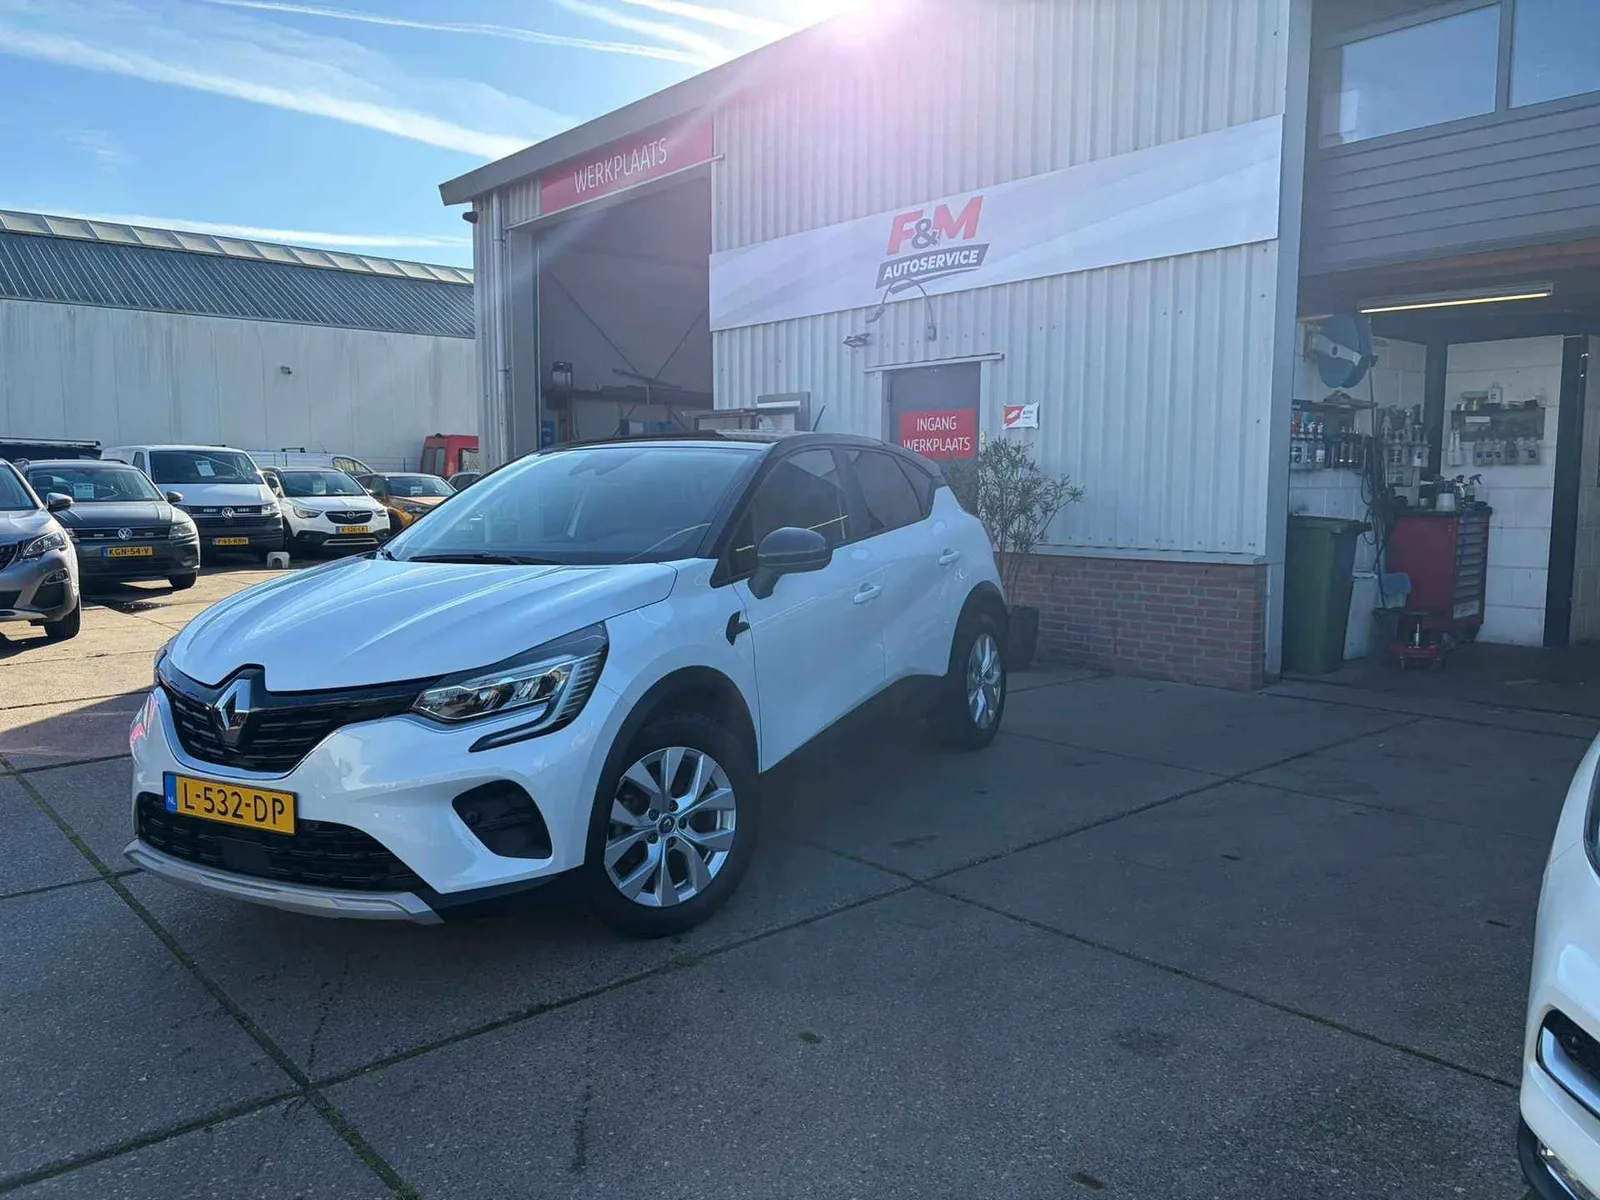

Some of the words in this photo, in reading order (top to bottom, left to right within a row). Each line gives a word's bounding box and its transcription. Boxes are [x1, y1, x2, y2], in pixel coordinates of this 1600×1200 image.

[574, 138, 668, 193] WERKPLAATS
[887, 195, 984, 256] F&M
[883, 250, 979, 280] AUTOSERVICE
[916, 416, 957, 431] INGANG
[903, 436, 971, 452] WERKPLAATS
[167, 795, 176, 805] NL
[184, 783, 285, 824] L-532-DP
